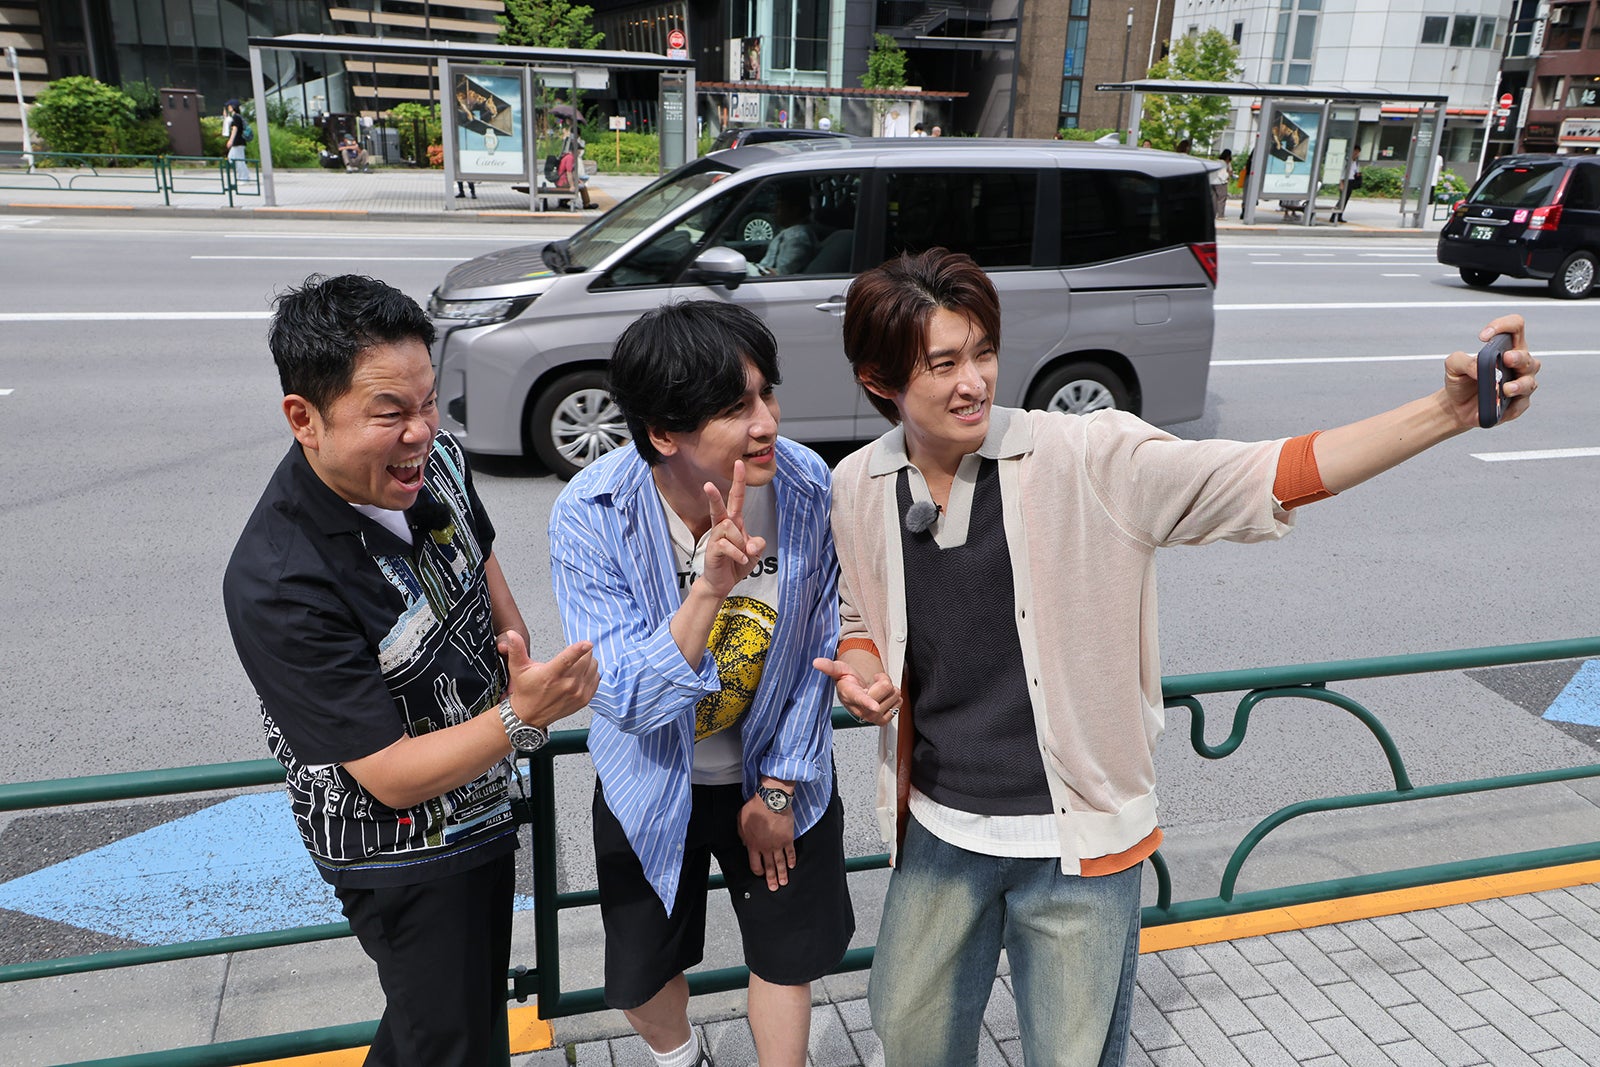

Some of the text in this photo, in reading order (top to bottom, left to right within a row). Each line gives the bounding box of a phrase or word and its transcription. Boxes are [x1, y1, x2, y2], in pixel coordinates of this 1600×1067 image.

[731, 93, 739, 118] P
[741, 102, 758, 118] 1600
[475, 157, 508, 168] Cartier
[1274, 178, 1295, 187] Cartier
